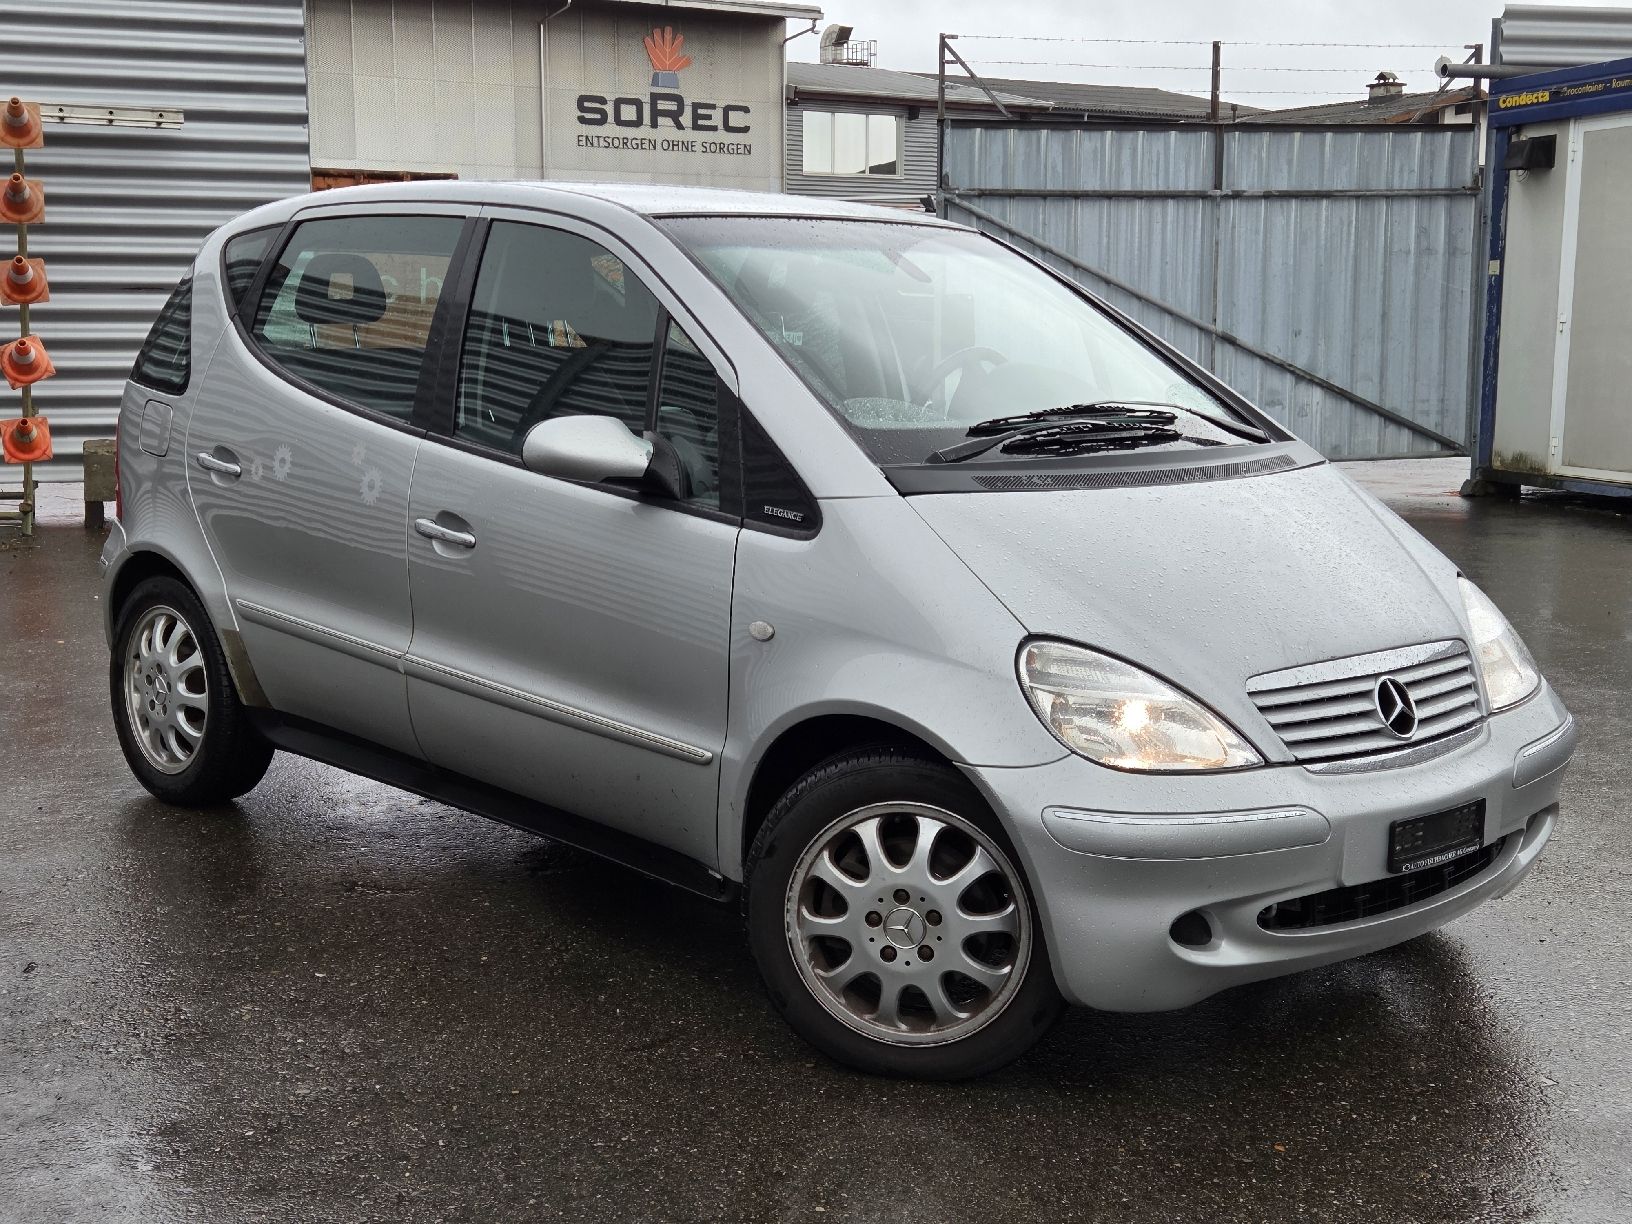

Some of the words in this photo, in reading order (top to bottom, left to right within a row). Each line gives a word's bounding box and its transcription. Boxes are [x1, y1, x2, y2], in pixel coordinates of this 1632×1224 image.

[1498, 89, 1550, 109] Condecta
[576, 91, 751, 134] SOREC
[576, 134, 657, 151] ENTSORGEN
[660, 138, 698, 153] OHNE
[701, 141, 752, 156] SORGEN
[763, 505, 805, 522] ELEGANCE
